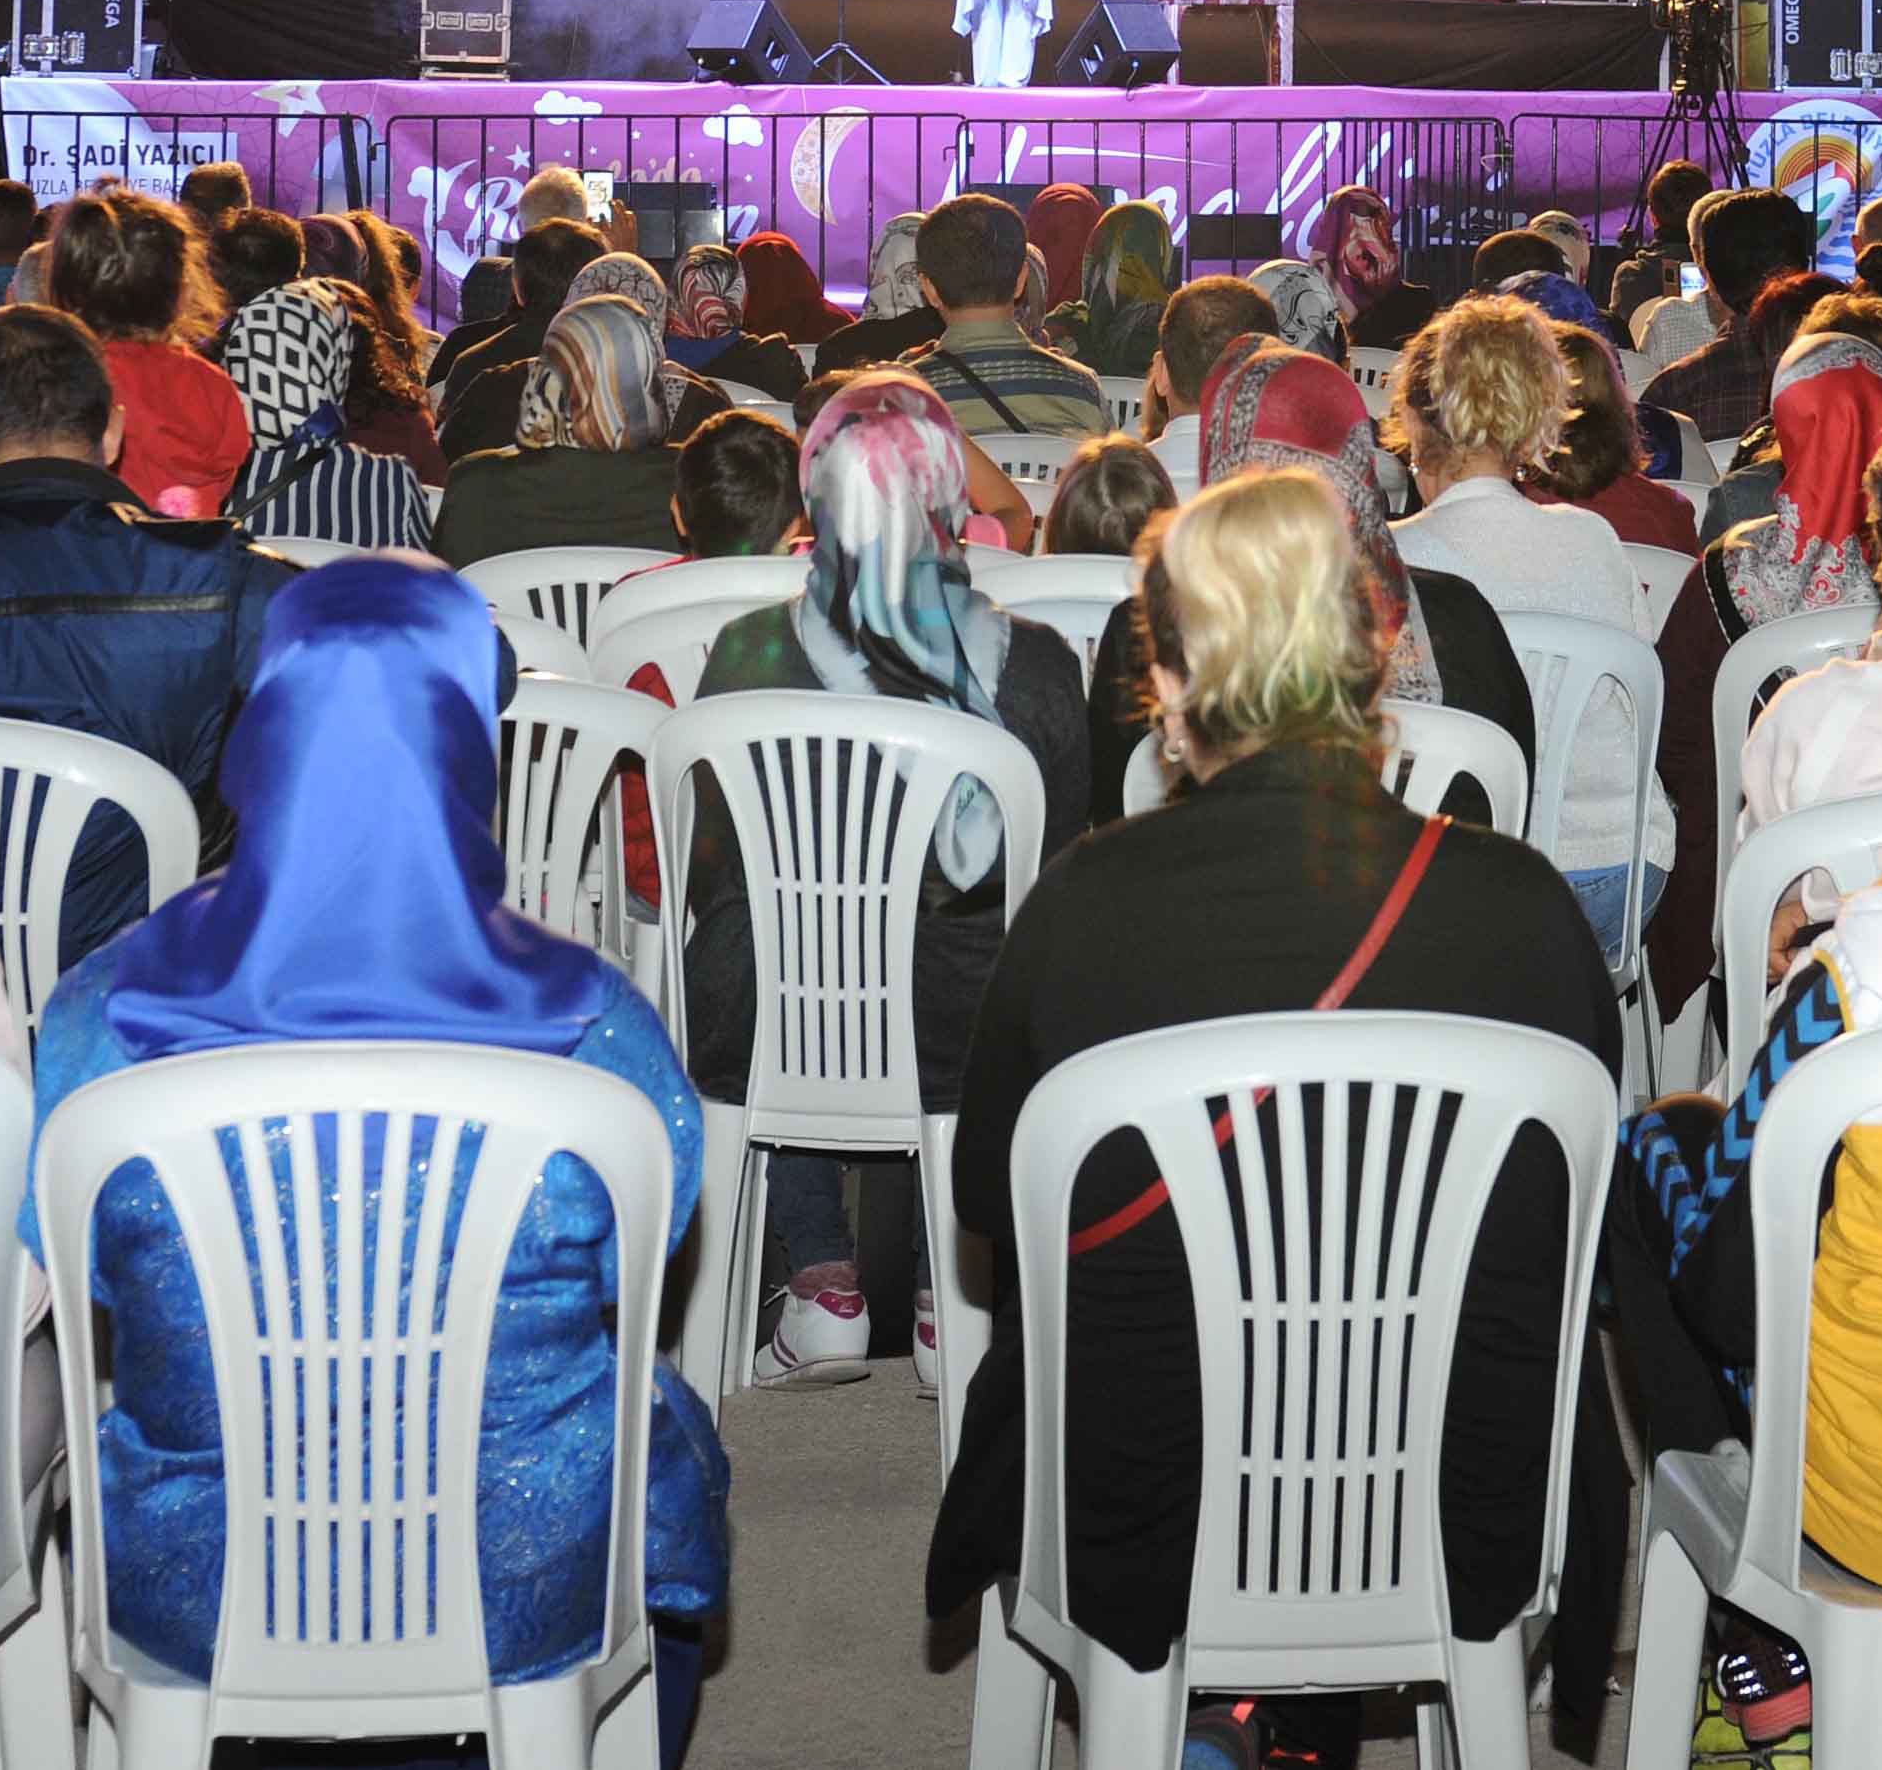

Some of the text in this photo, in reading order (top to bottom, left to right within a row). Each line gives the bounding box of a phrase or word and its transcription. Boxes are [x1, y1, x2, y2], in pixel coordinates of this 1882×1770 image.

[22, 144, 56, 167] Dr.
[135, 144, 215, 166] YAZICI
[26, 179, 69, 196] UZLA
